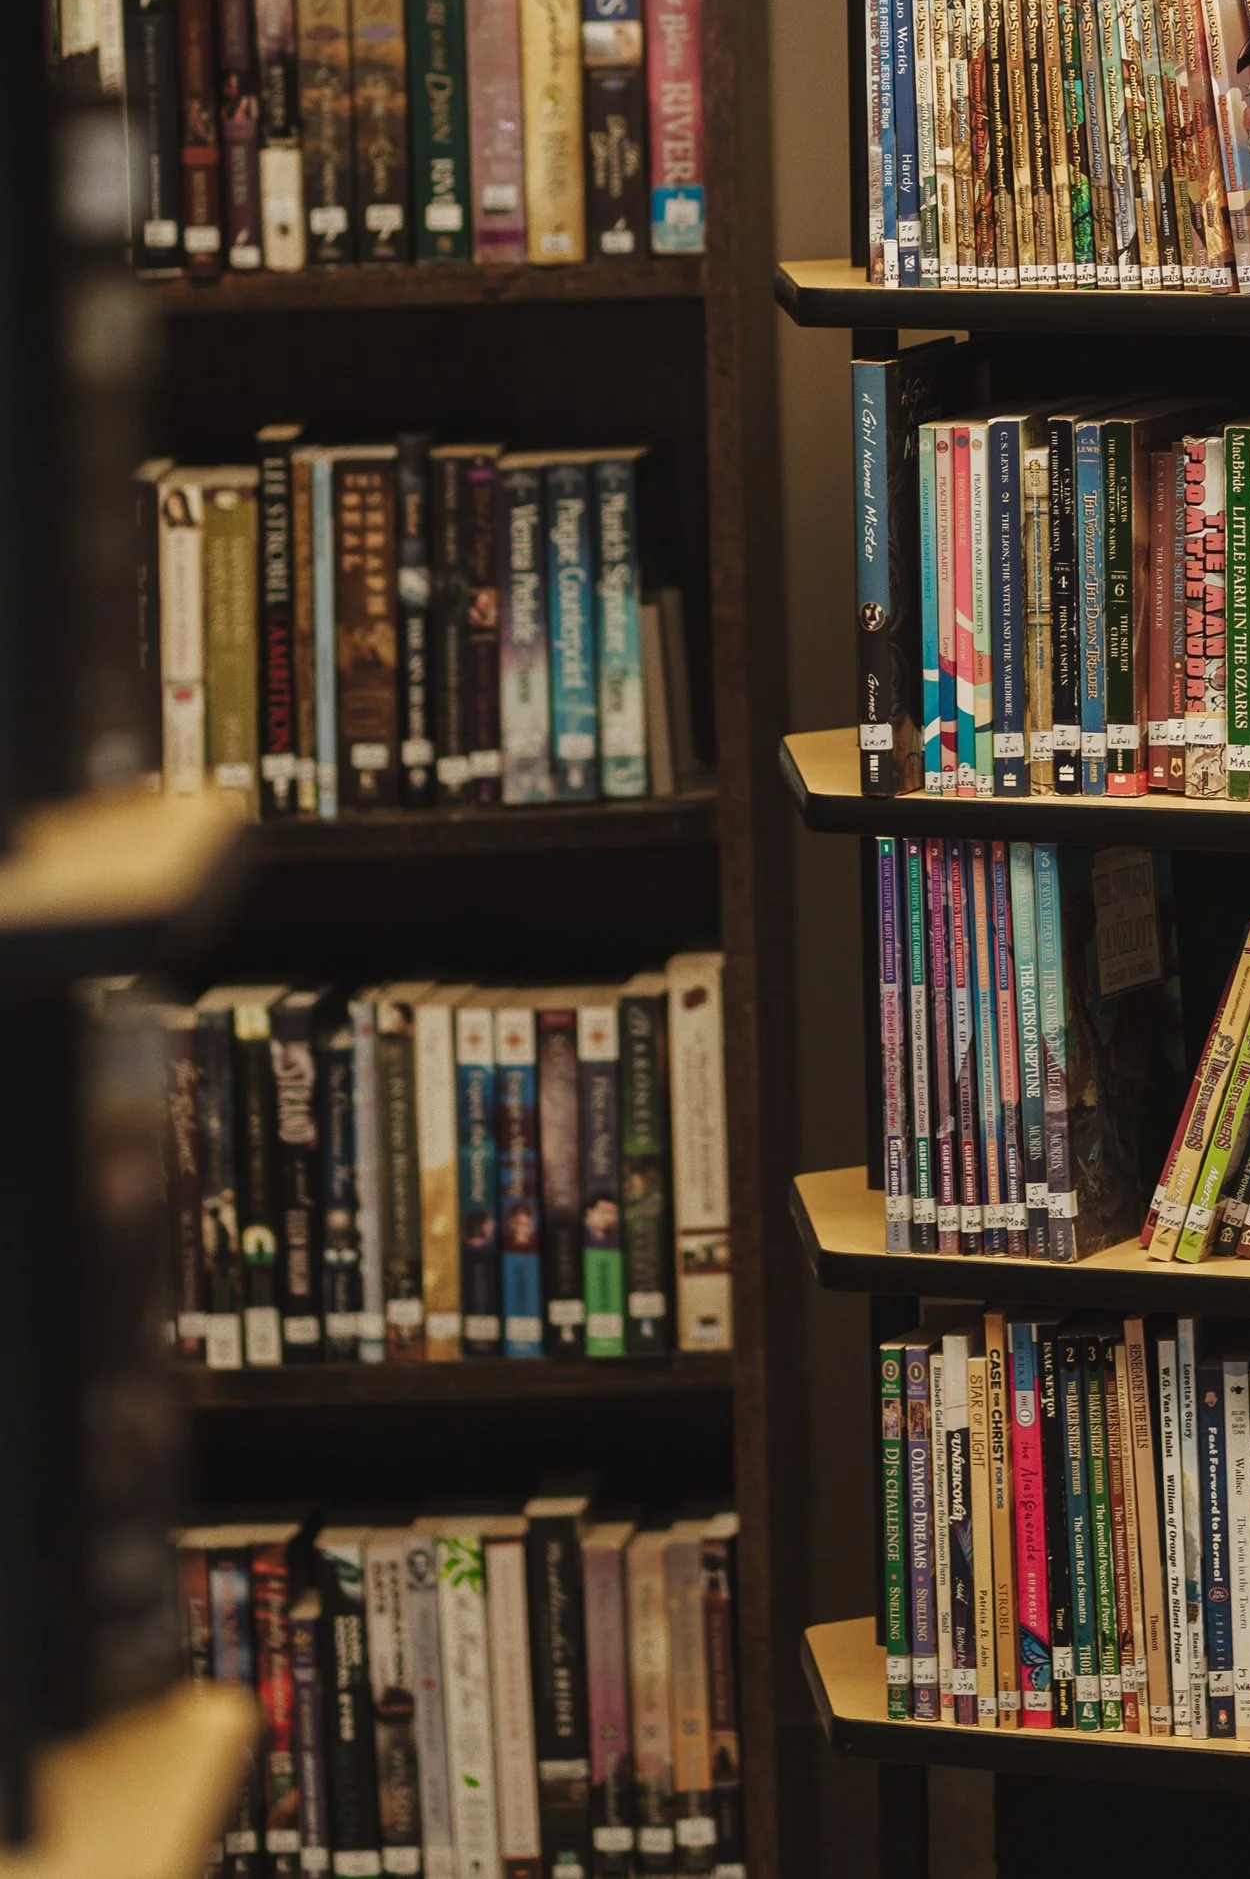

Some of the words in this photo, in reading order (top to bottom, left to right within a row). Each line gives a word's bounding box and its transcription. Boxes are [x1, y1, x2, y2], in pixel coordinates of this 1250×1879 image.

[897, 27, 908, 75] Worlds
[659, 81, 696, 187] RIVER
[901, 154, 912, 193] Hardy
[862, 409, 877, 446] Girl
[863, 449, 875, 499] Named
[1232, 433, 1245, 493] MacBride
[864, 505, 878, 563] Mister
[1232, 506, 1246, 561] LITTLE
[1233, 563, 1247, 608] FARM
[1059, 605, 1067, 643] PRINCE
[1060, 644, 1068, 686] CASPIAN
[1235, 634, 1248, 665] THE
[1235, 668, 1248, 729] OZARKS
[1024, 1044, 1040, 1098] NEPTUNE
[970, 1375, 983, 1407] STAR
[989, 1348, 1001, 1389] CASE
[1129, 1344, 1144, 1392] RENEGADE
[1183, 1363, 1192, 1409] Loretta's
[972, 1431, 985, 1468] LIGHT
[991, 1409, 1004, 1464] CHRIST
[1184, 1412, 1192, 1439] Story
[885, 1447, 900, 1475] DJ'S
[911, 1448, 926, 1508] OLYMPIC
[1235, 1458, 1245, 1496] Wallace
[885, 1478, 900, 1561] CHALLENGE
[912, 1512, 927, 1569] DREAMS
[1212, 1533, 1223, 1582] Normal
[889, 1586, 900, 1640] SNELLING
[998, 1584, 1009, 1638] STROBEL
